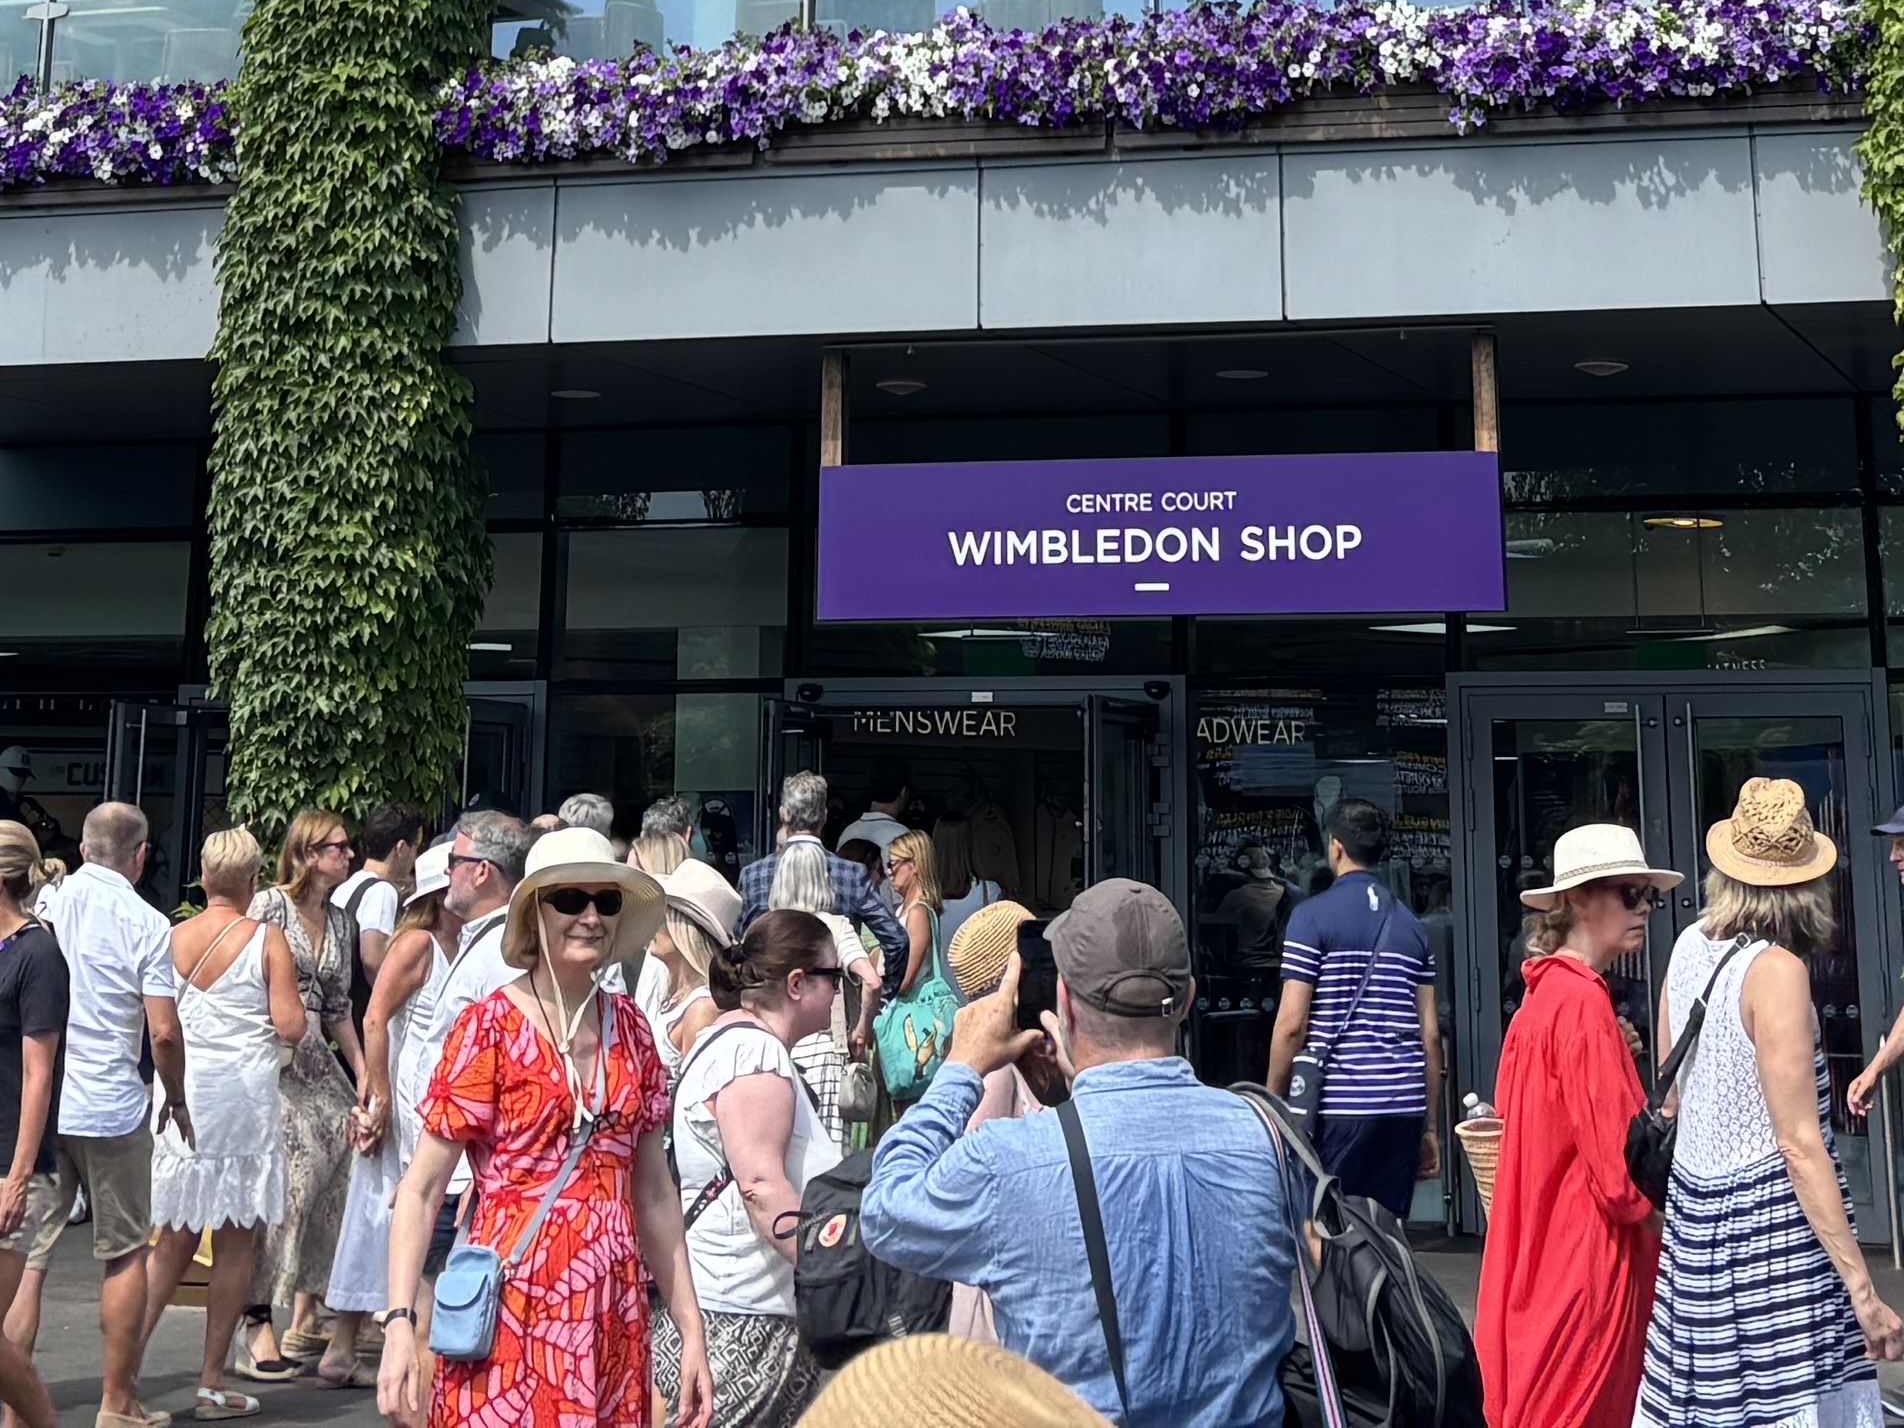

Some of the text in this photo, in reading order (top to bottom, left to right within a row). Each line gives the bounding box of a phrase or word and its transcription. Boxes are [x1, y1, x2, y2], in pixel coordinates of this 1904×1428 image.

[1066, 491, 1237, 514] CENTRE COURT
[948, 525, 1364, 566] WIMBLEDON SHOP
[854, 710, 1016, 737] MENSWEAR
